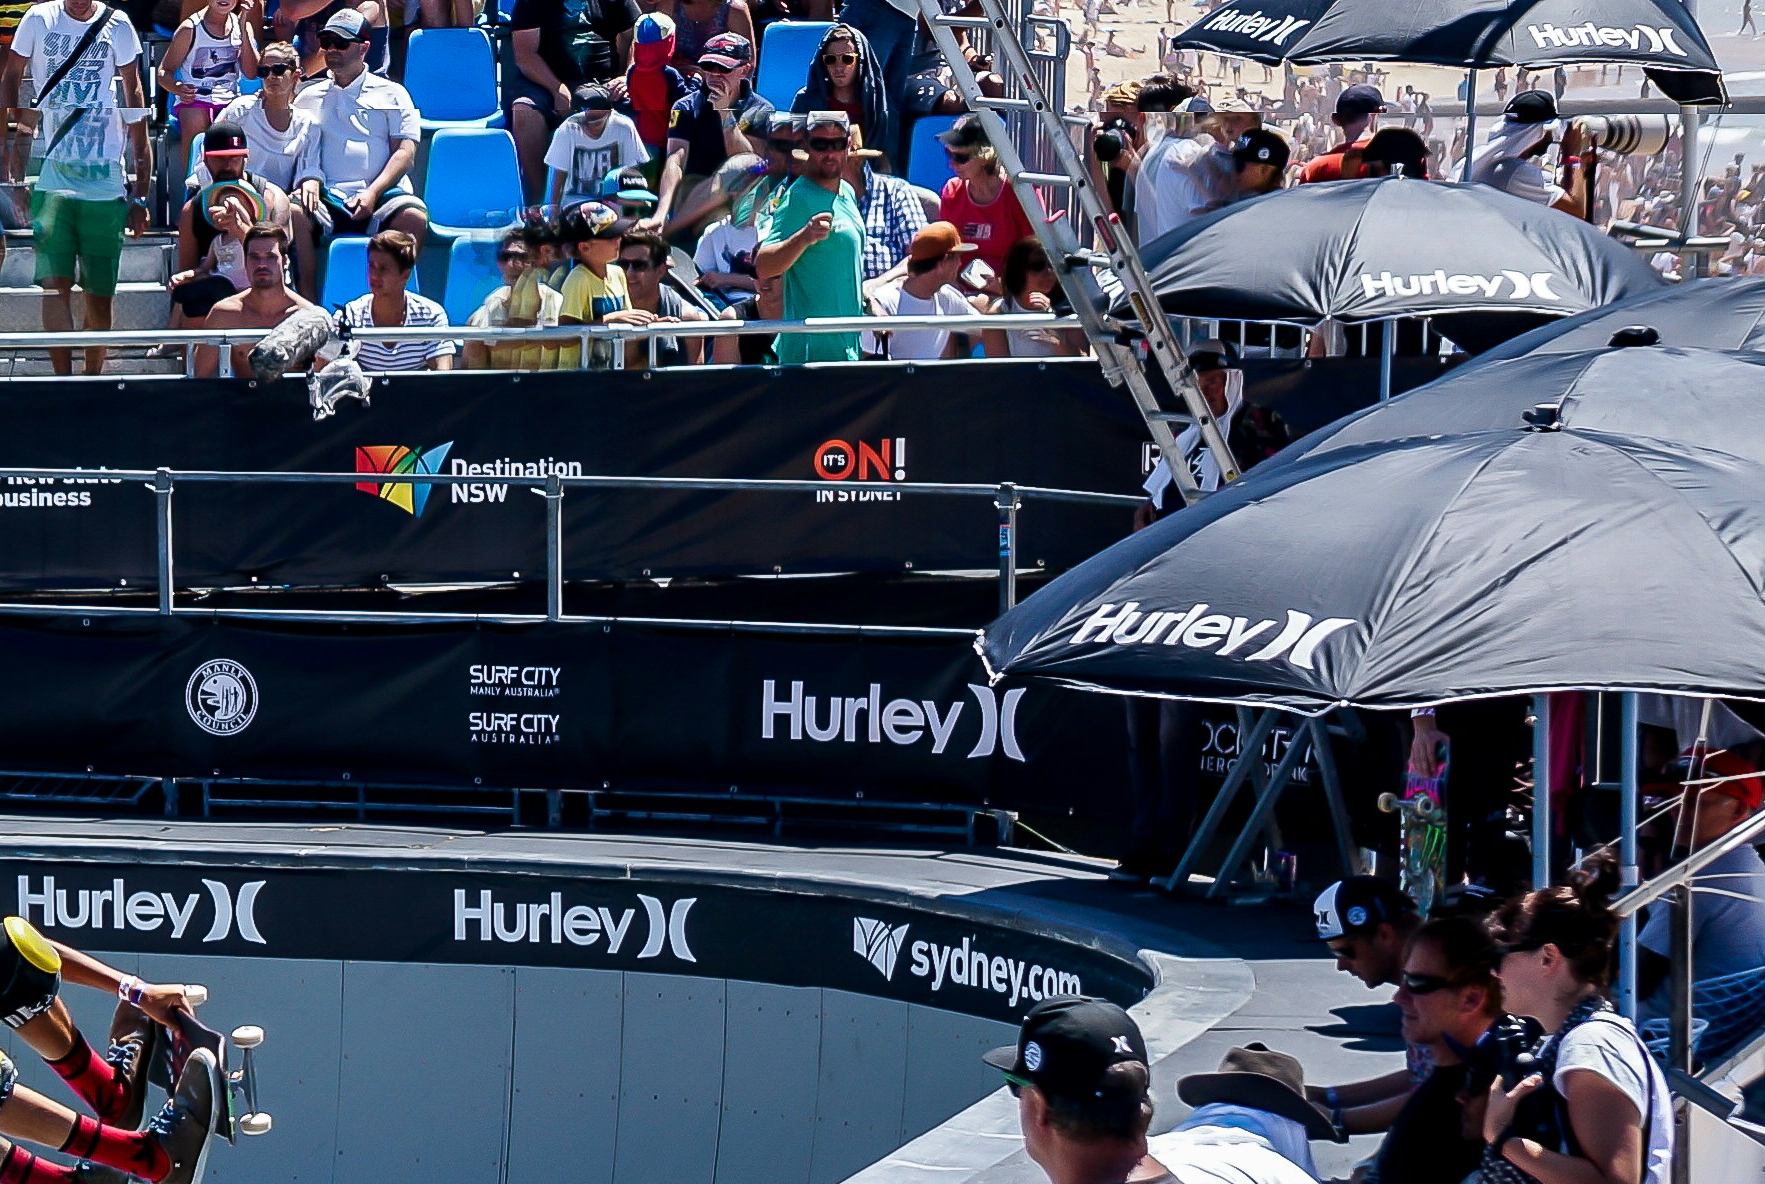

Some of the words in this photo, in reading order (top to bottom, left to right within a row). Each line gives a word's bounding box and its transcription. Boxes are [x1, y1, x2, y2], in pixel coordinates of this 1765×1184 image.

[1203, 9, 1281, 39] Hurley
[1528, 23, 1639, 50] Hurley
[1361, 269, 1504, 298] Hurley
[451, 457, 582, 477] Destination
[823, 454, 846, 467] IT'S
[451, 483, 508, 503] NSW
[1070, 602, 1276, 658] Hurley
[201, 664, 244, 680] MANLY
[469, 664, 519, 684] SURF
[521, 666, 561, 686] CITY
[470, 686, 500, 695] MANLY
[196, 710, 249, 730] COUNCIL
[469, 712, 518, 731] SURF
[520, 713, 560, 733] CITY
[762, 680, 965, 753] Hurley
[17, 875, 200, 938] Hurley
[454, 889, 635, 953] Hurley
[910, 936, 1082, 1006] sydney.com
